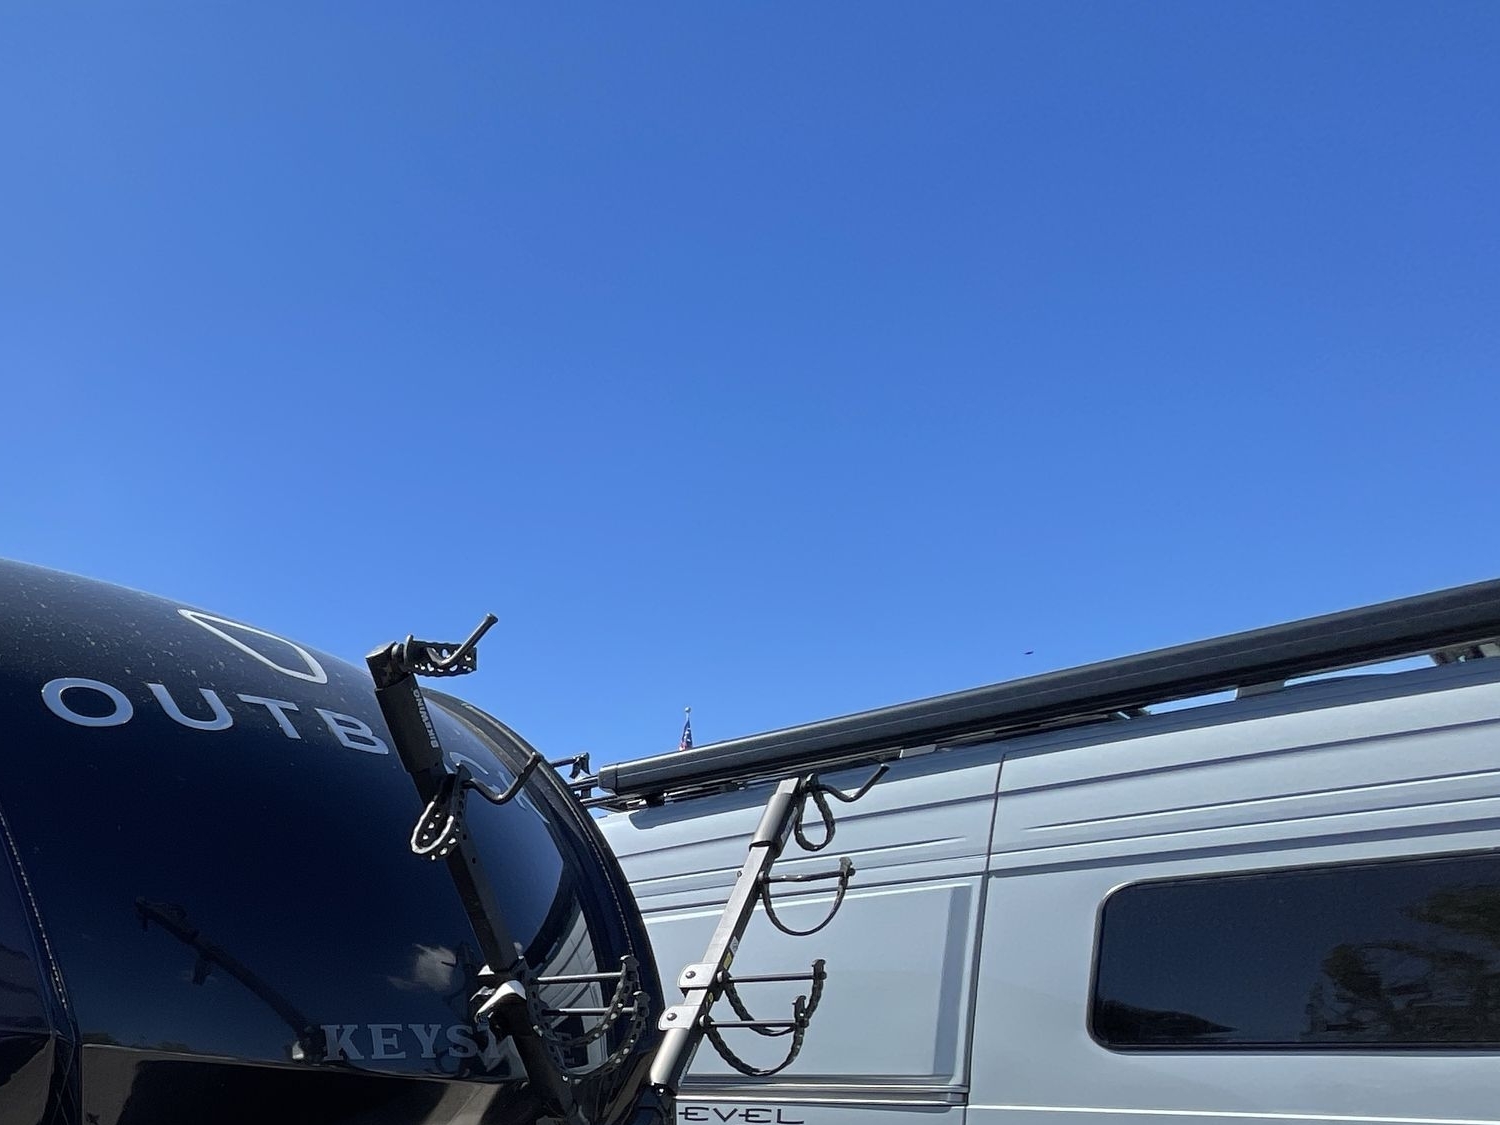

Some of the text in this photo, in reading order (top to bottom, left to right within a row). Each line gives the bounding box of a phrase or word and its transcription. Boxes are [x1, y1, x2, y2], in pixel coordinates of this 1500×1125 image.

[413, 688, 439, 748] BIKEWING
[41, 677, 550, 824] OUTBCK
[678, 1106, 804, 1125] EVEL
